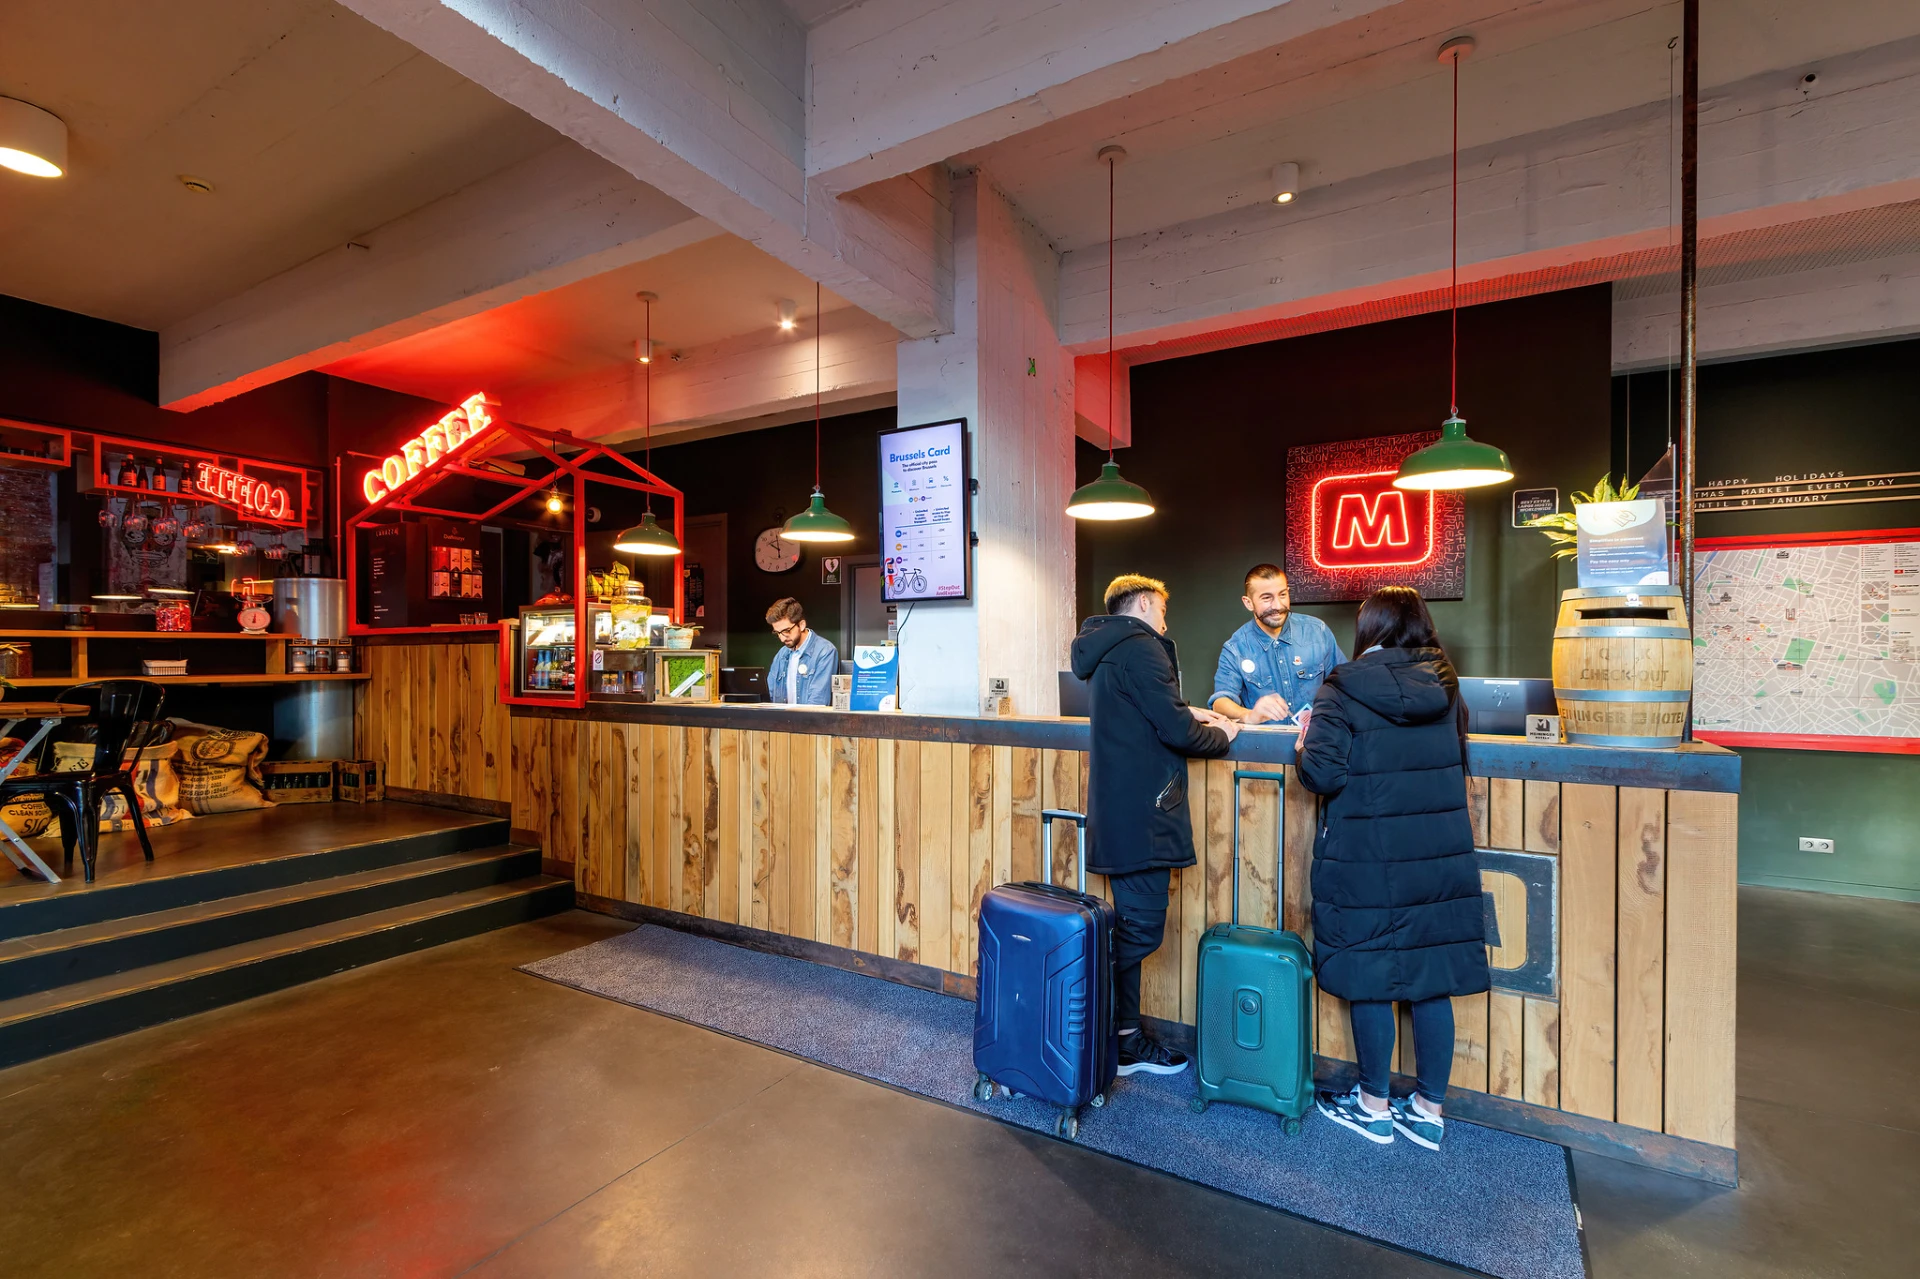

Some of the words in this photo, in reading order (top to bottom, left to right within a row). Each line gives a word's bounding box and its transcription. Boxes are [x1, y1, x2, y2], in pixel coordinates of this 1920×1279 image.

[363, 391, 492, 504] COFFEE
[889, 450, 925, 463] Brussels
[927, 445, 951, 457] Card
[1708, 478, 1748, 487] HAPPY
[1775, 471, 1845, 482] HOLIDAYS
[1741, 485, 1792, 496] MARKET
[1807, 481, 1851, 491] EVERY
[1867, 478, 1895, 487] DAY
[1741, 498, 1757, 507] 01
[1769, 494, 1828, 505] JANUARY
[1333, 491, 1409, 549] M
[1580, 668, 1669, 684] CHECK-OUT
